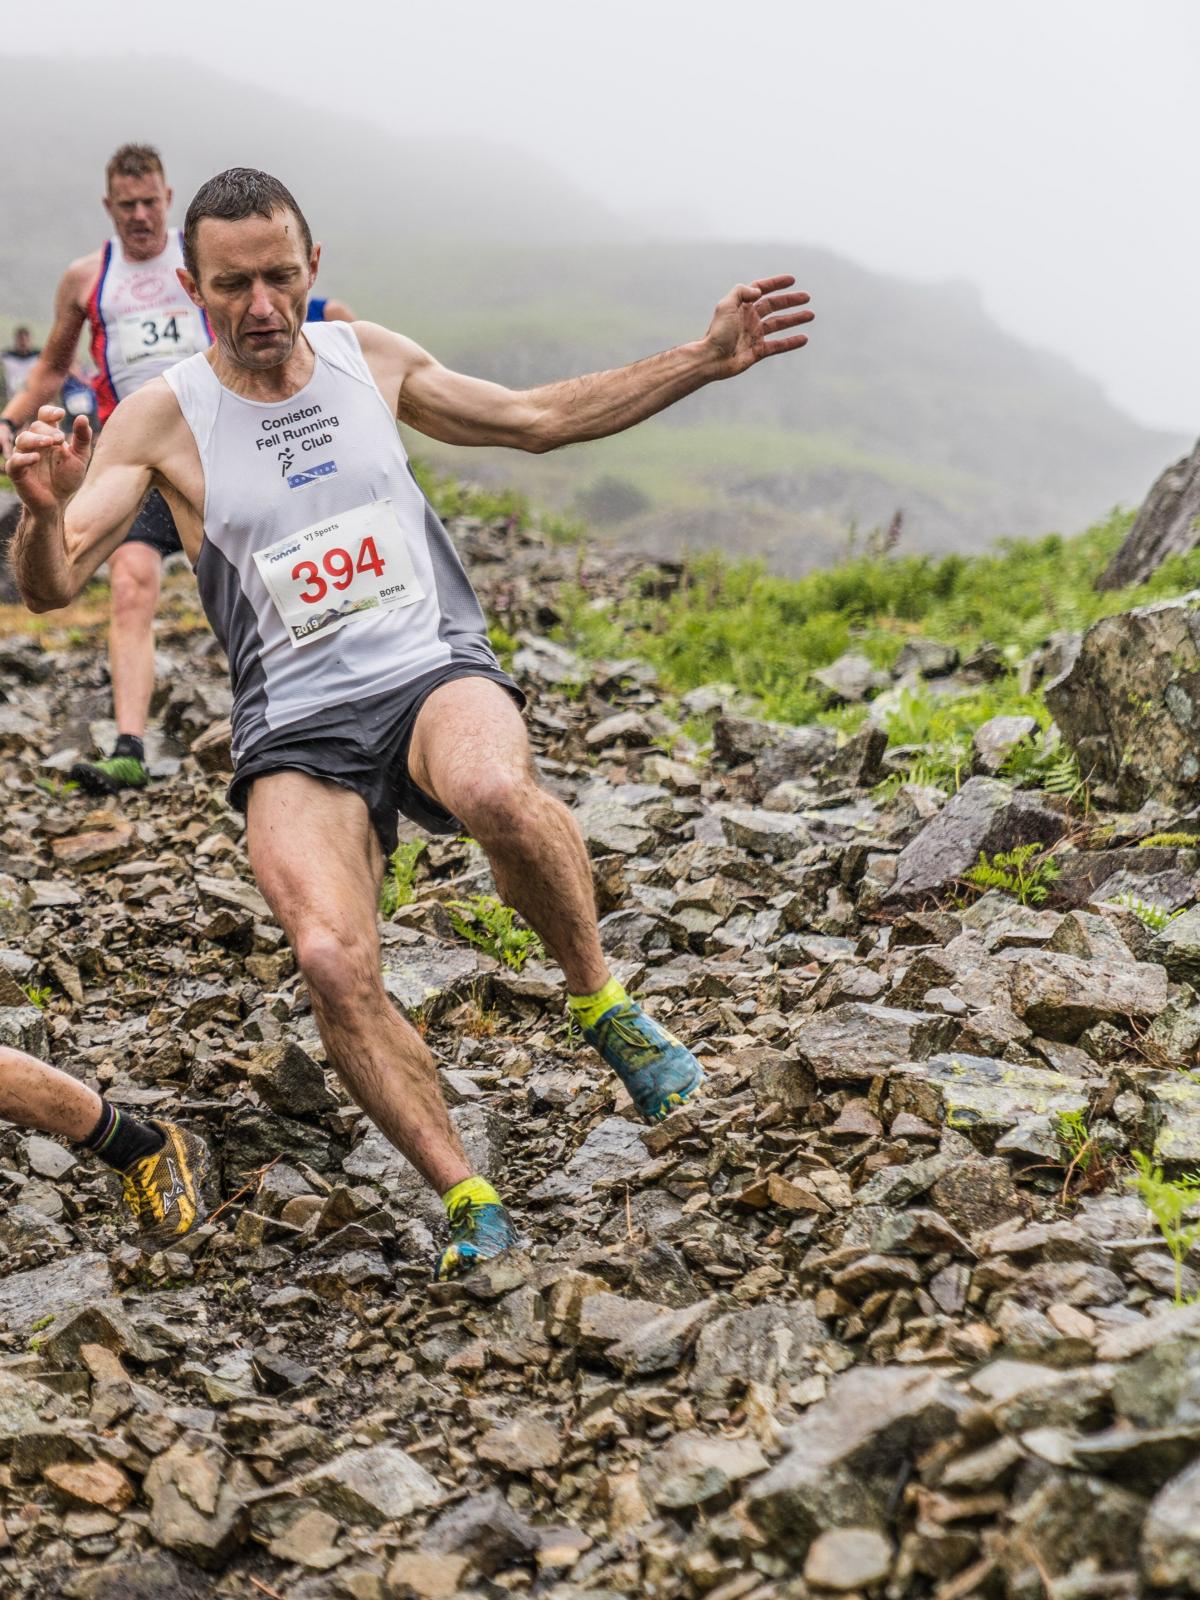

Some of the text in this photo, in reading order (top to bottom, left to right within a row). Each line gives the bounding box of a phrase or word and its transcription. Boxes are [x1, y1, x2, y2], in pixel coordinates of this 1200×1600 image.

[141, 316, 181, 345] 34
[261, 404, 322, 431] Coniston
[255, 415, 340, 451] Fell Running
[301, 433, 333, 451] Club
[303, 523, 340, 542] VJ Sports
[269, 543, 301, 563] runner
[291, 536, 386, 604] 394
[379, 584, 406, 598] BOFRA
[295, 619, 319, 637] 2019
